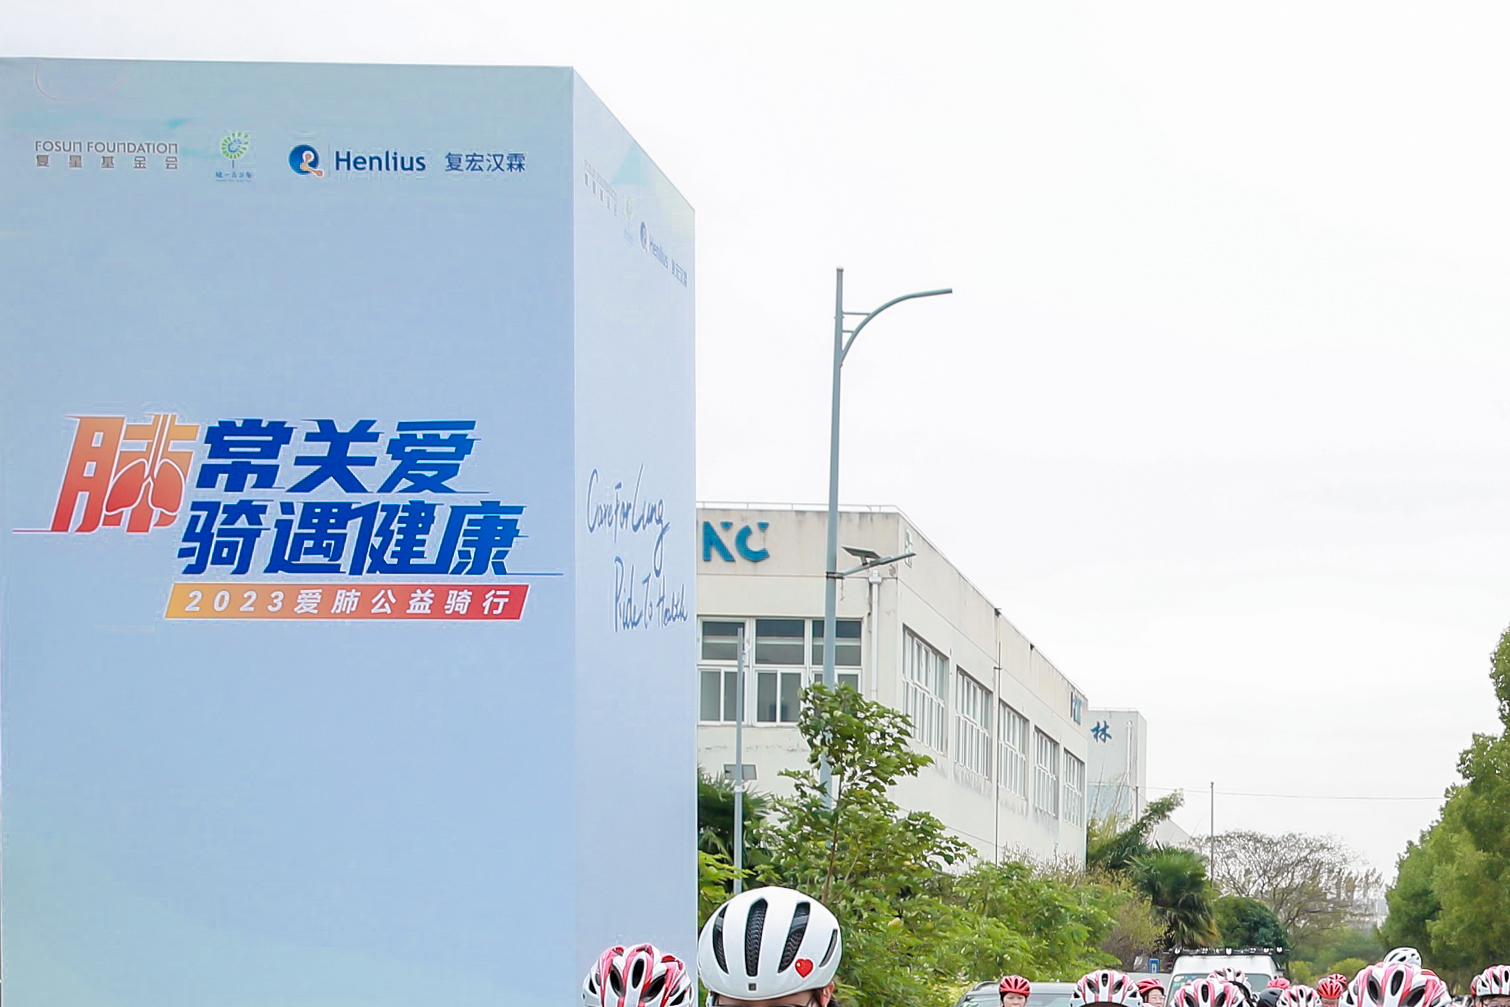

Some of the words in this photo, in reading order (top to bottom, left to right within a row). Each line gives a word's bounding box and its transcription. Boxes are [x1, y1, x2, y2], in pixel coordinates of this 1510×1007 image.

[34, 140, 83, 153] FOSUN
[87, 141, 179, 155] FOUNDATION
[334, 150, 427, 172] Henlius
[444, 152, 527, 173] 复宏汉霖
[177, 499, 529, 576] 骑遇健康
[184, 587, 514, 615] 2023爱肺公益骑行
